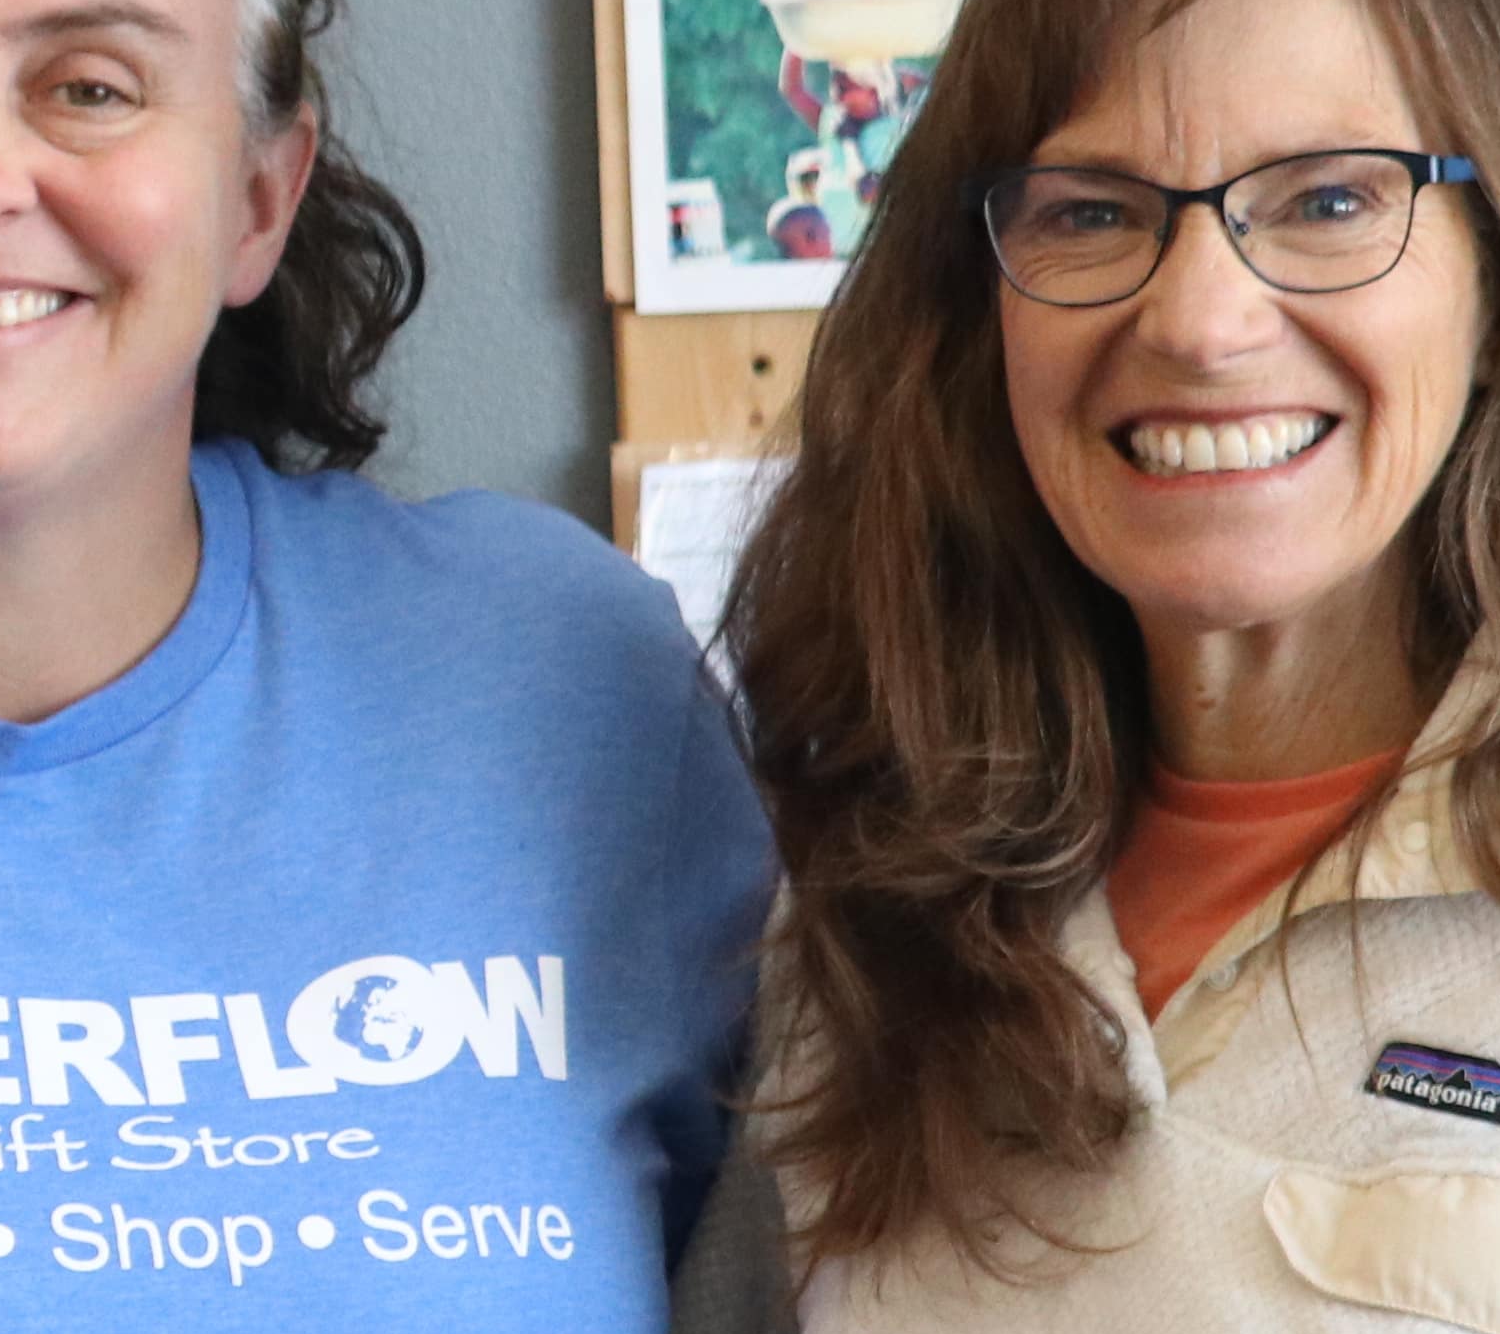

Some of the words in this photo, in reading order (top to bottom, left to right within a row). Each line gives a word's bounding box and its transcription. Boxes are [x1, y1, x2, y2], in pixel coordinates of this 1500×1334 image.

[1376, 1072, 1499, 1113] patagonia
[110, 1116, 382, 1172] Store
[49, 1202, 276, 1288] Shop
[356, 1188, 576, 1263] Serve
